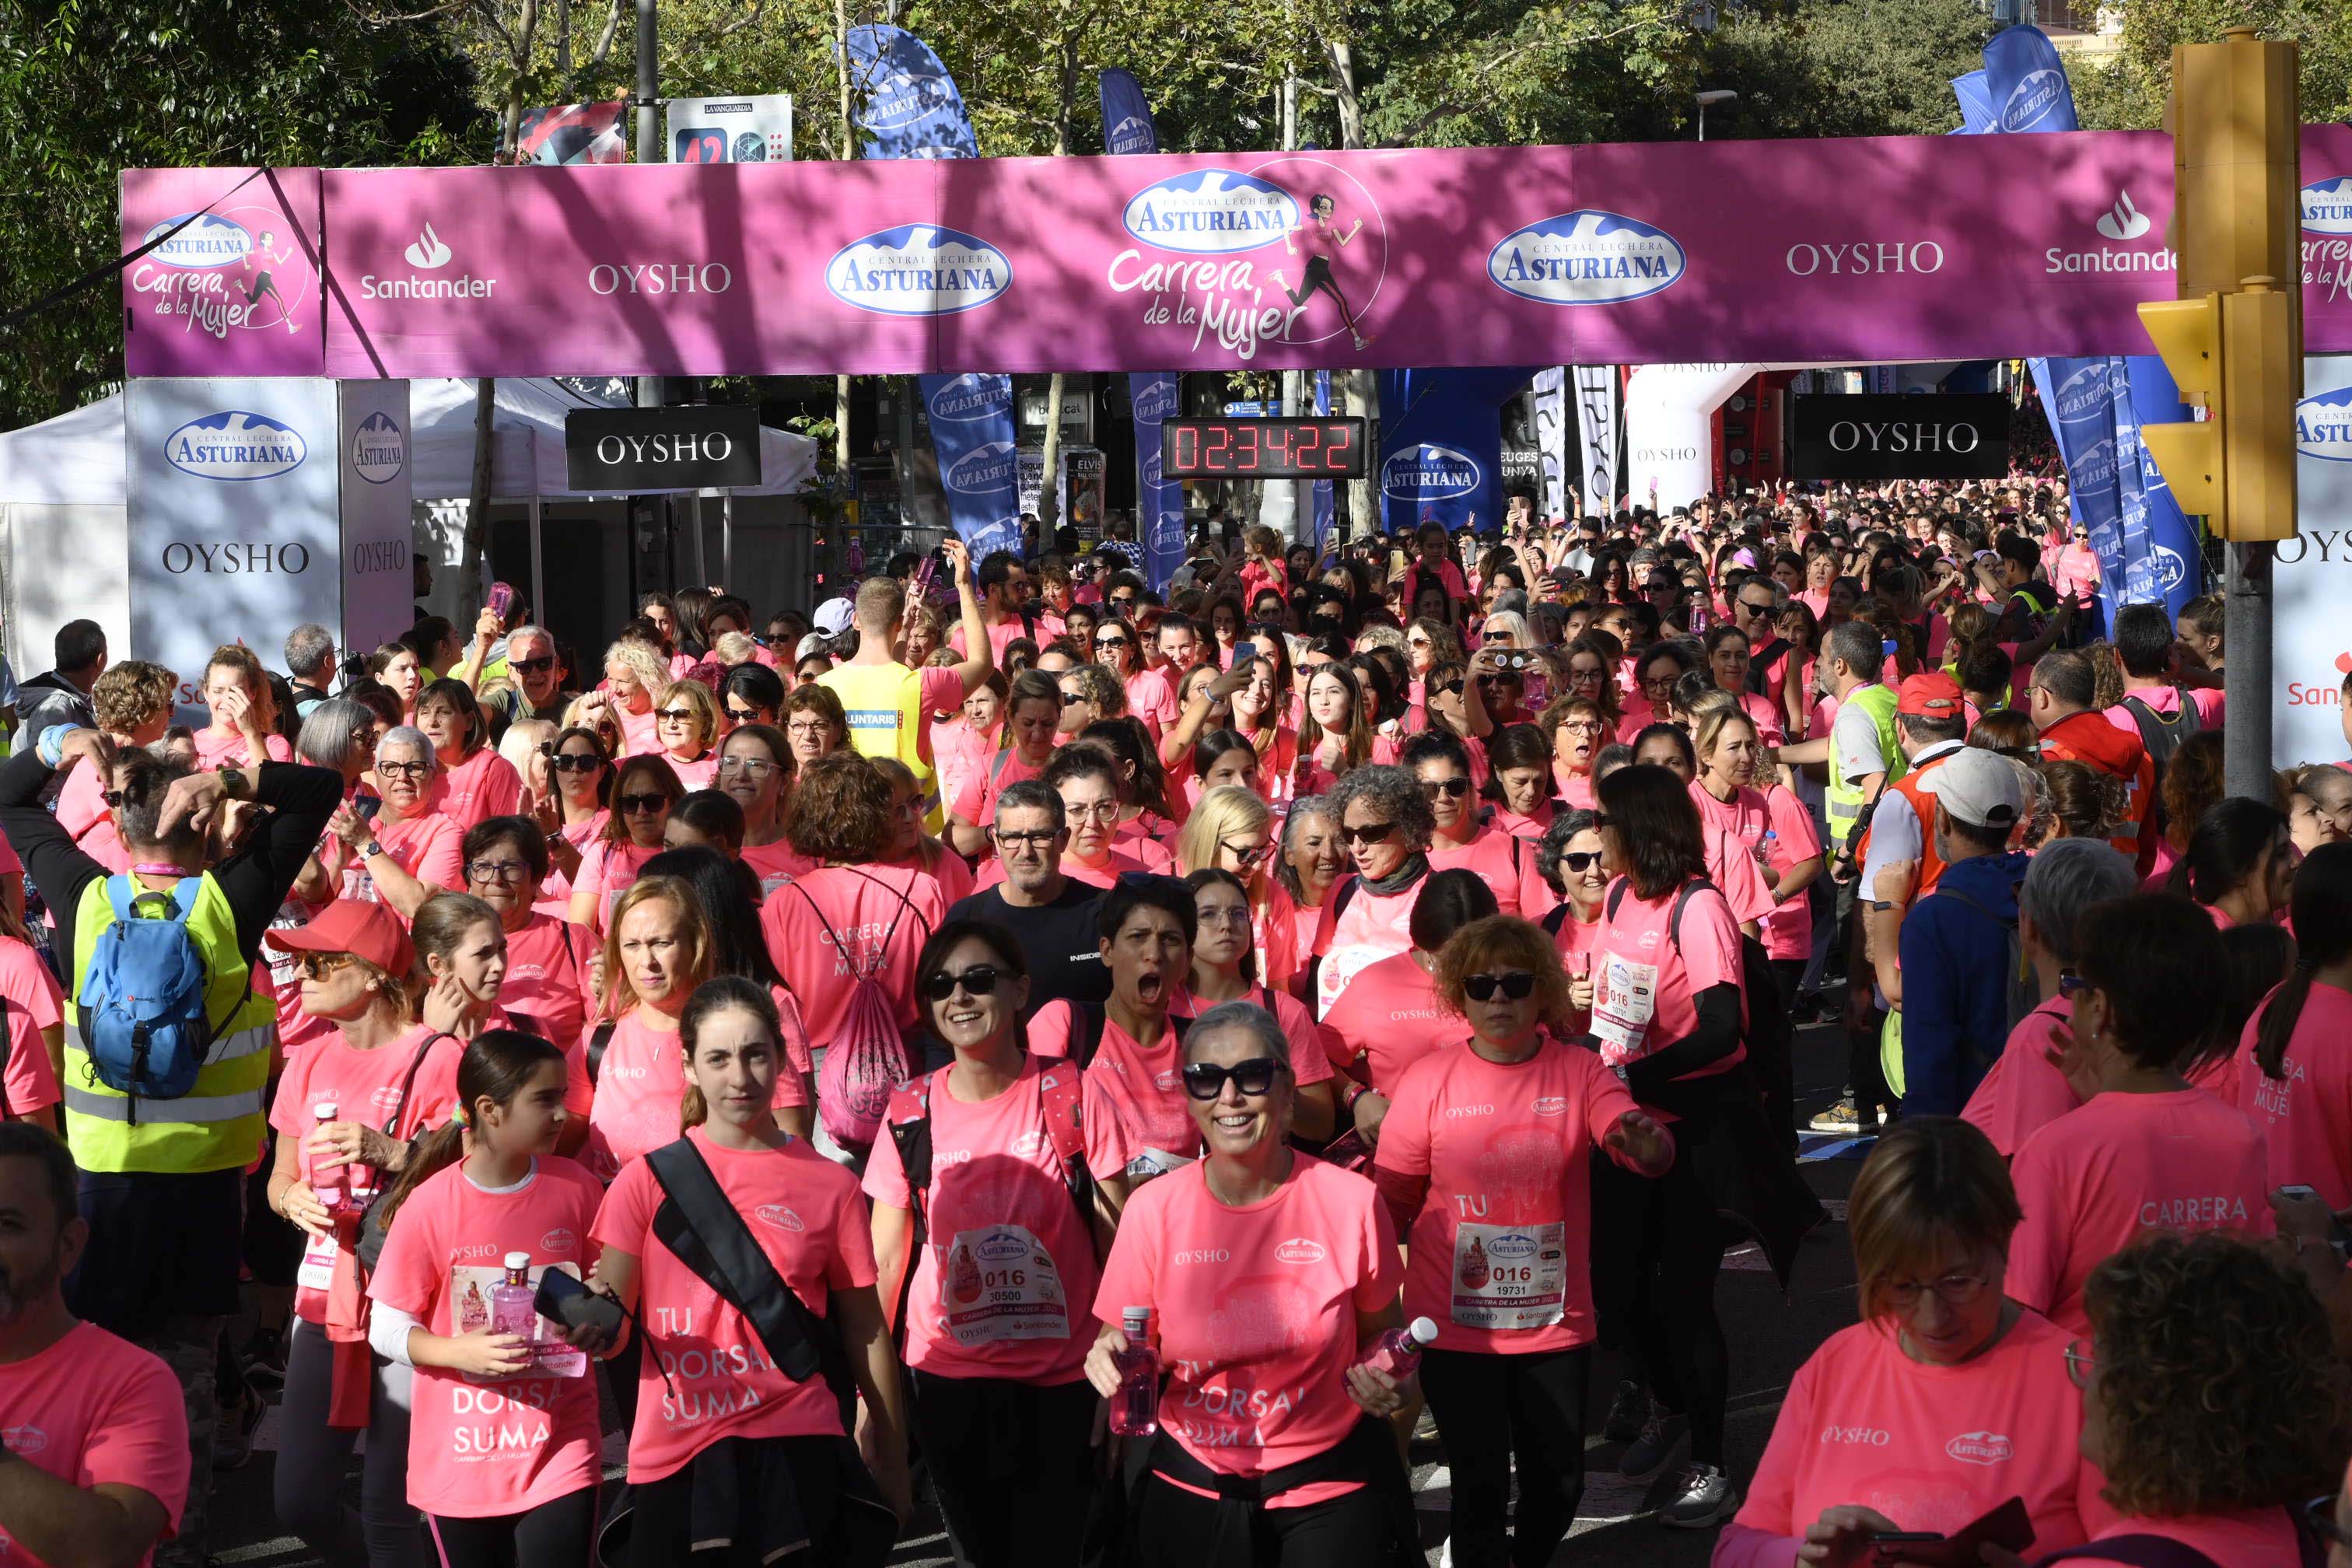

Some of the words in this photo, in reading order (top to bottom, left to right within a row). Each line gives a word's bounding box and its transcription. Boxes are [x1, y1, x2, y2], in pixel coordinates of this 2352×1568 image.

[1162, 197, 1220, 206] CENTRAL
[1224, 196, 1282, 206] LECHERA
[1136, 200, 1286, 233] ASTURIANA
[152, 233, 244, 254] ASTURIANA
[1533, 243, 1594, 254] CENTRAL
[1601, 241, 1664, 251] LECHERA
[869, 256, 926, 265] CENTRAL
[933, 254, 992, 264] LECHERA
[1503, 247, 1671, 282] ASTURIANA
[1786, 241, 1944, 275] OYSHO
[132, 264, 226, 293] Carrera
[588, 263, 731, 294] OYSHO
[839, 258, 998, 292] ASTURIANA
[1107, 248, 1255, 292] Carrera
[2317, 262, 2331, 284] la
[361, 275, 497, 299] Santander
[155, 295, 173, 315] de
[176, 293, 188, 315] la
[186, 290, 260, 339] Mujer
[1143, 294, 1171, 325] de
[1176, 293, 1196, 325] la
[1192, 288, 1308, 360] Mujer
[597, 432, 732, 464] OYSHO
[1175, 426, 1350, 469] 02:34:22
[1829, 421, 1979, 453] OYSHO
[175, 436, 297, 463] ASTURIANA
[355, 438, 401, 467] ASTURIANA
[1637, 446, 1697, 462] OYSHO
[1019, 460, 1044, 471] Segur
[1077, 460, 1102, 470] ELVIS
[1502, 466, 1538, 477] UNYA
[1020, 472, 1033, 481] que
[1385, 467, 1473, 489] ASTURIANA
[1020, 502, 1036, 512] este
[162, 542, 310, 574] OYSHO
[353, 539, 405, 574] OYSHO
[845, 714, 895, 724] LUNTARIS
[862, 938, 883, 957] LA
[512, 970, 544, 979] ASTURIANA
[834, 954, 887, 977] MUJER
[1610, 989, 1628, 1006] 016
[1391, 1010, 1437, 1021] OYSHO
[1446, 1104, 1494, 1119] OYSHO
[1535, 1101, 1567, 1112] ASTURIANA
[1454, 1194, 1489, 1217] TU
[2140, 1196, 2248, 1227] CARRERA
[759, 1209, 801, 1230] ASTURIANA
[1174, 1248, 1230, 1265] OYSHO
[1278, 1247, 1322, 1258] ASTURIANA
[1491, 1242, 1535, 1252] ASTURIANA
[985, 1269, 1026, 1288] 016
[1493, 1266, 1531, 1282] 016
[989, 1290, 1021, 1303] 30500
[1496, 1286, 1526, 1295] 19731
[656, 1307, 692, 1336] TU
[963, 1309, 992, 1321] CARRERA
[1461, 1313, 1498, 1321] OYSHO
[663, 1384, 761, 1422] SUMA
[453, 1421, 550, 1454] SUMA
[1820, 1425, 1890, 1447] OYSHO
[1951, 1441, 2009, 1458] ASTURIANA
